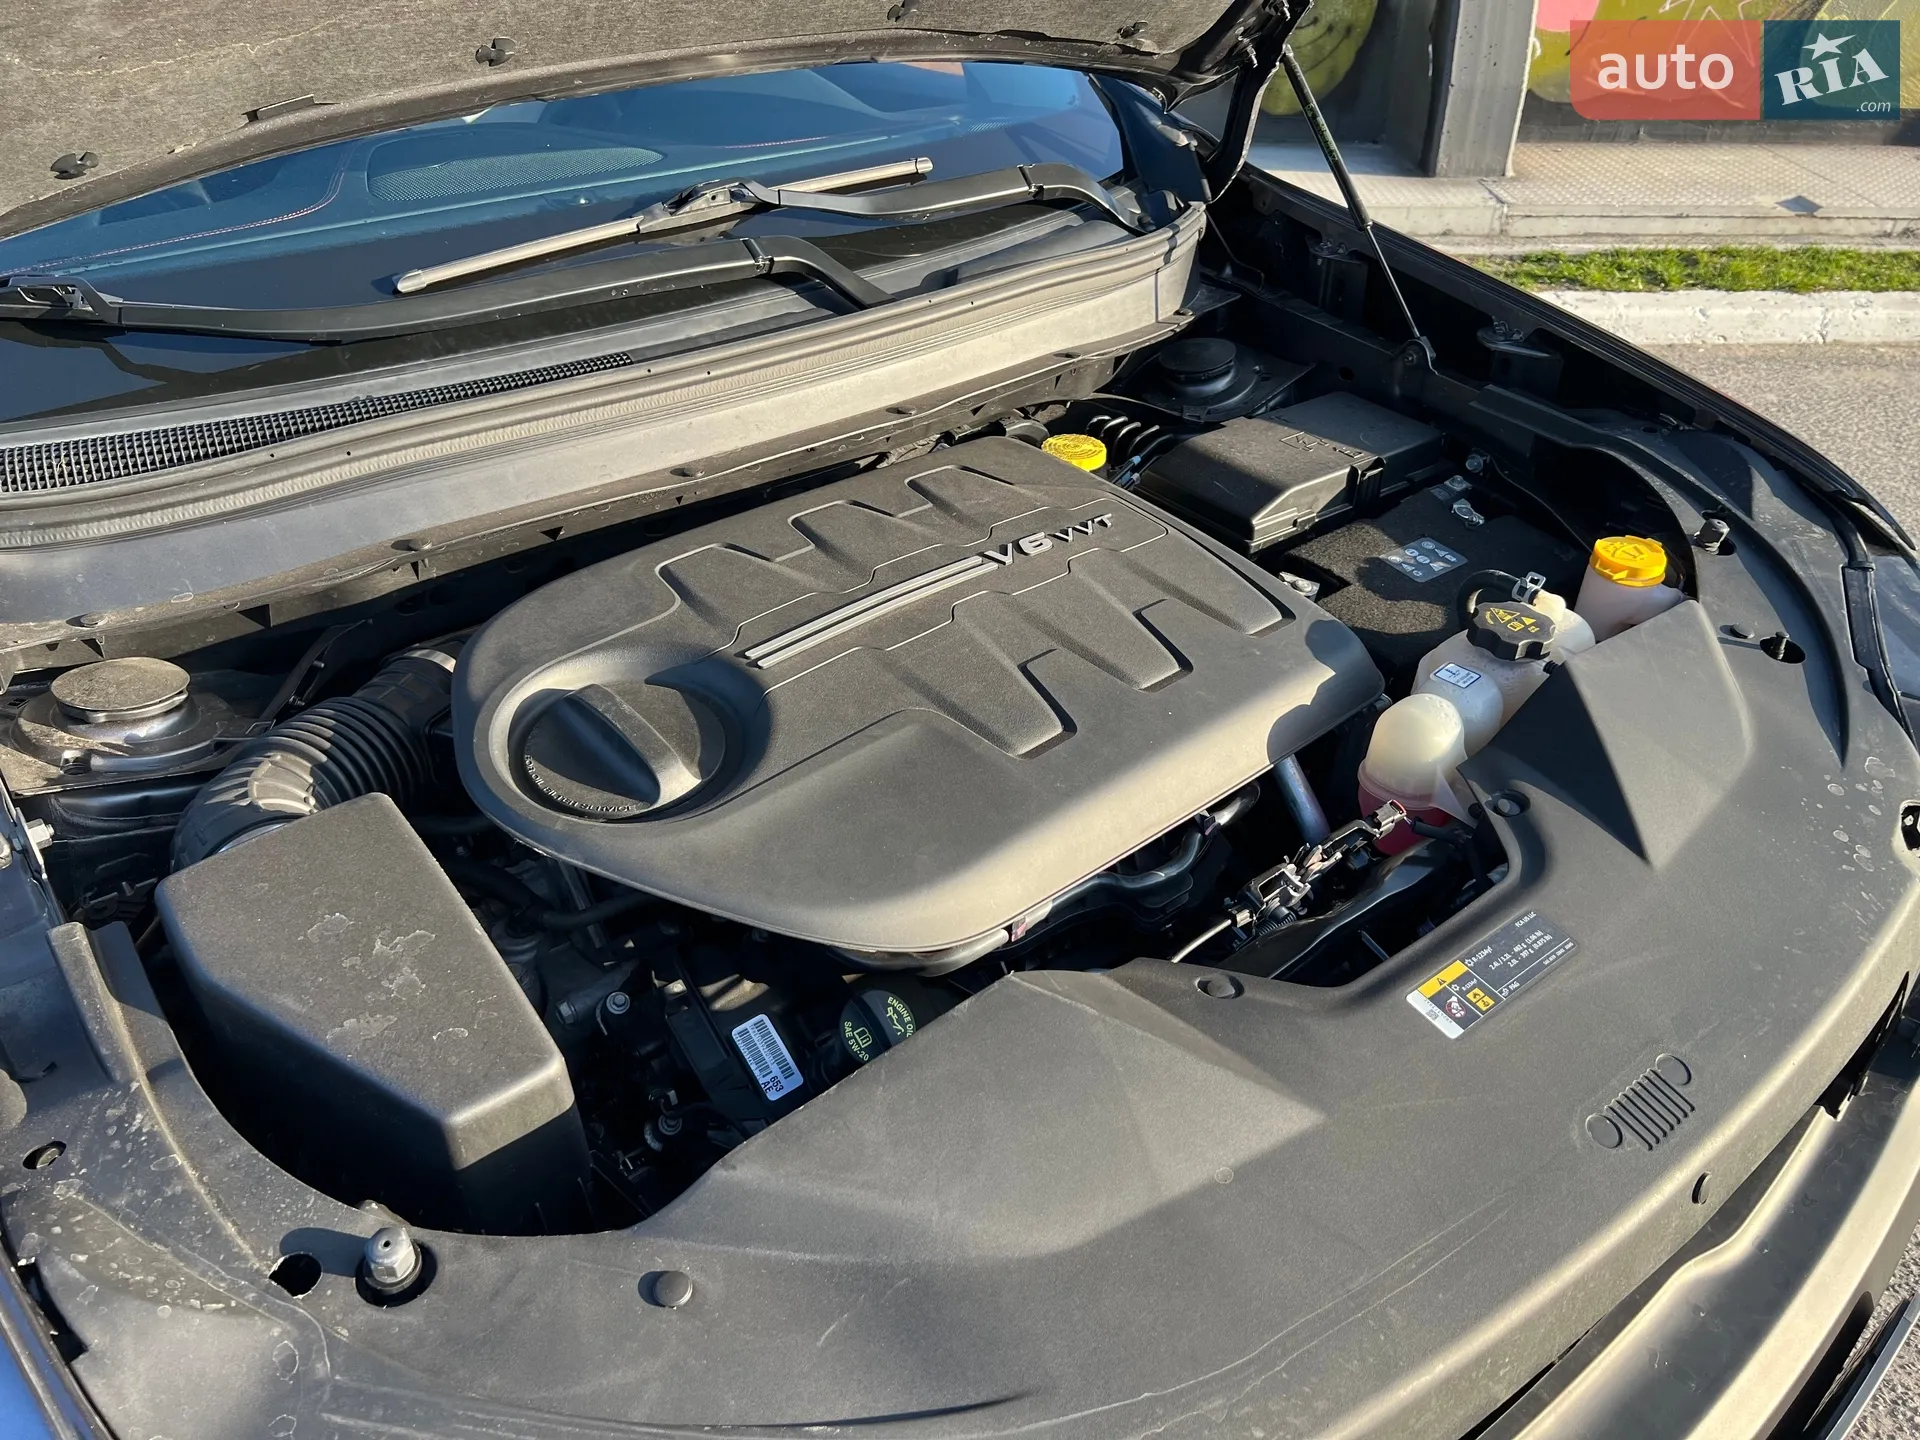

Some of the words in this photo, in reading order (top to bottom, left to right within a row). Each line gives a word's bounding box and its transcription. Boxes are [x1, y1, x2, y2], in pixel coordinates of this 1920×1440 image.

[983, 532, 1053, 565] V6
[1055, 513, 1112, 542] VVT
[532, 773, 545, 789] OIL
[544, 786, 578, 807] FILTER
[581, 803, 636, 812] SERVICE
[1472, 946, 1492, 962] R-1234yf
[887, 997, 911, 1023] ENGINE
[906, 1023, 915, 1037] OIL
[844, 1021, 853, 1038] SAE
[849, 1038, 869, 1061] 5W-20
[761, 1081, 774, 1094] AE
[769, 1076, 784, 1092] 653
